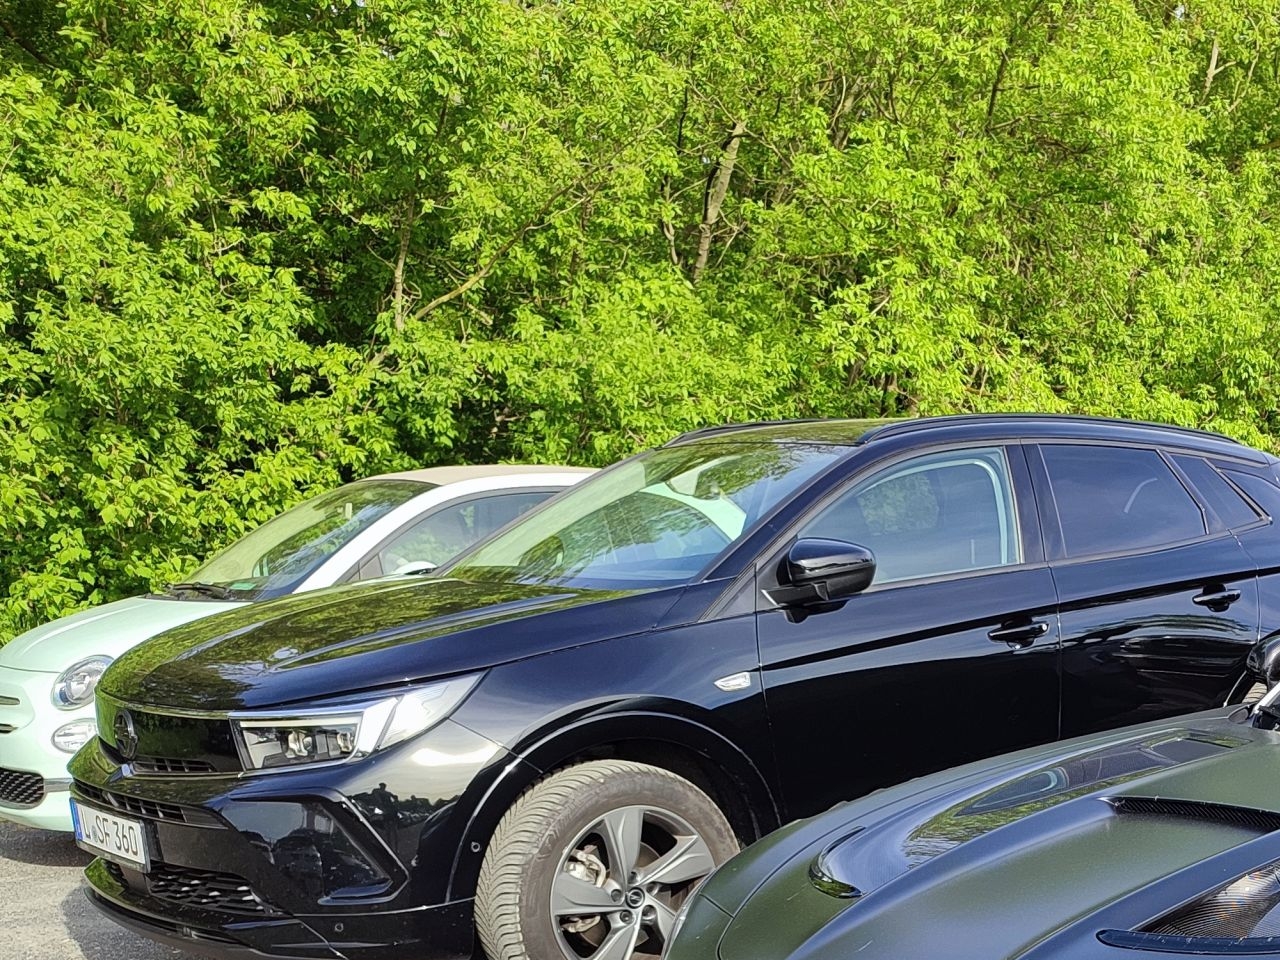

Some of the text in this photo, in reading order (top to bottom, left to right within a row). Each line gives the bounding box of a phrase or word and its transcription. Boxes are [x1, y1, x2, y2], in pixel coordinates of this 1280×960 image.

[81, 808, 139, 857] L SF 360
